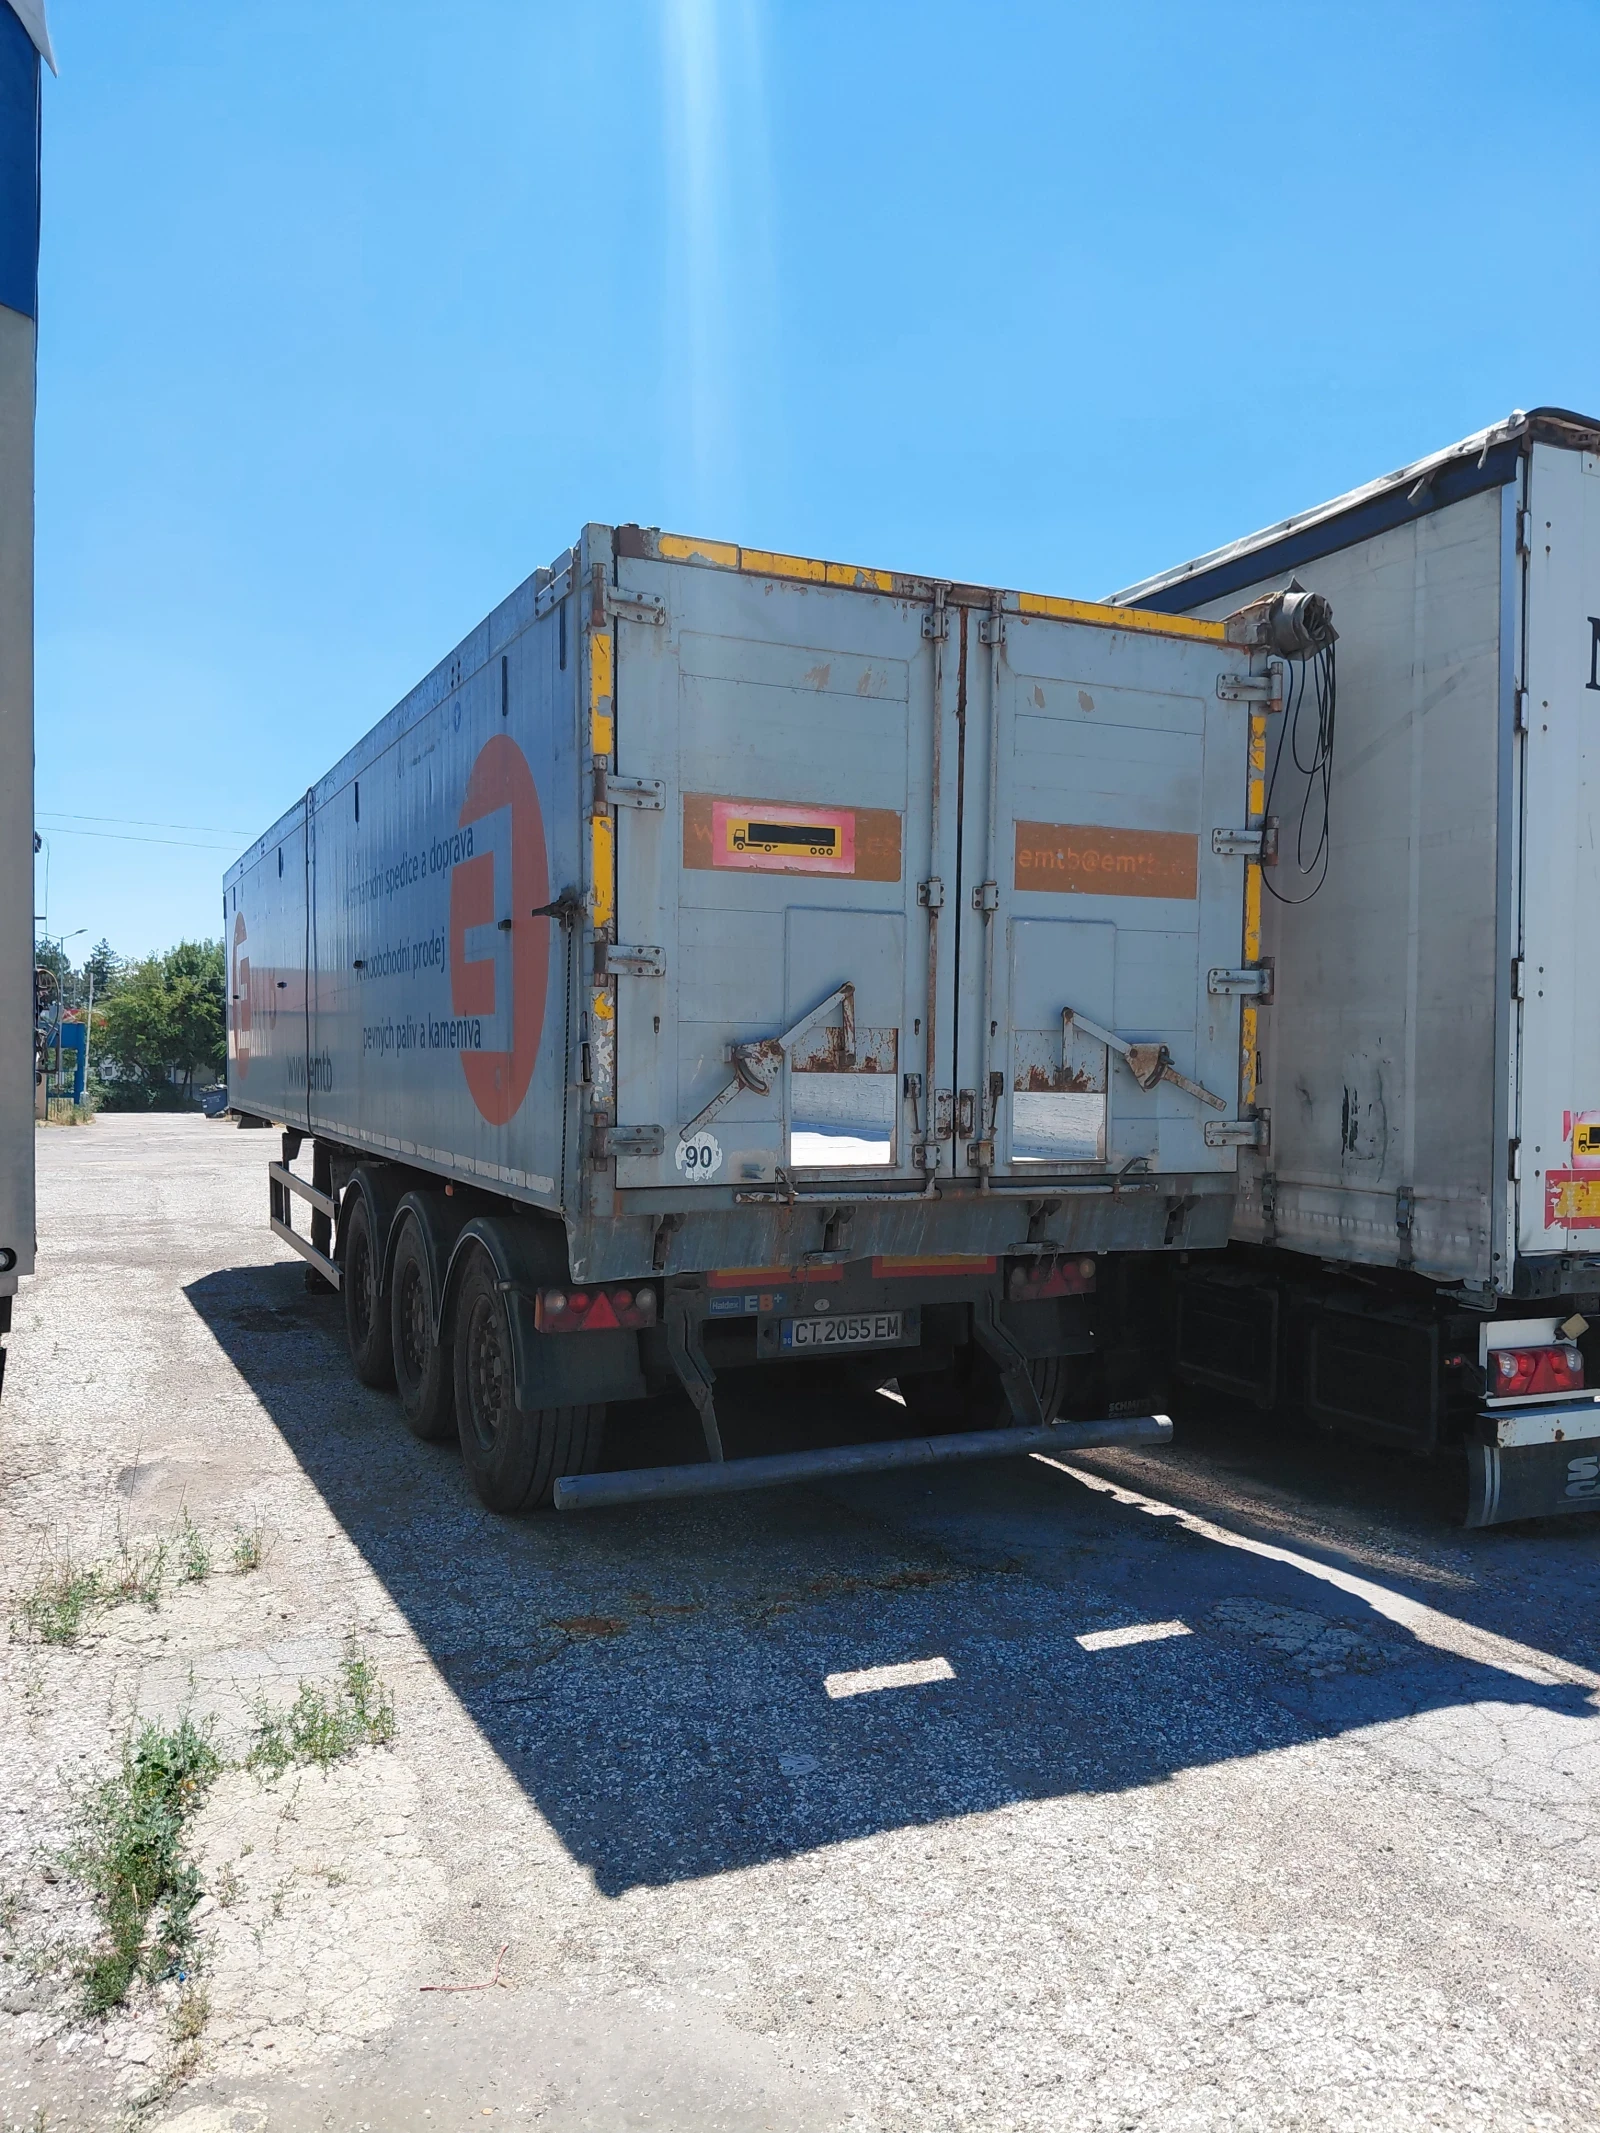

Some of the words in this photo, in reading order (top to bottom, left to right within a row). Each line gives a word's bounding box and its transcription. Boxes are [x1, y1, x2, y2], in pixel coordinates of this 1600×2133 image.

[386, 852, 419, 901] spedice
[421, 851, 427, 878] a
[430, 827, 474, 880] doprava
[412, 926, 445, 979] prodej
[363, 1016, 395, 1057] pevných
[396, 1014, 418, 1058] paliv
[420, 1022, 426, 1049] a
[428, 1010, 482, 1049] kameniva
[685, 1145, 713, 1169] 90
[711, 1300, 740, 1311] Haldex
